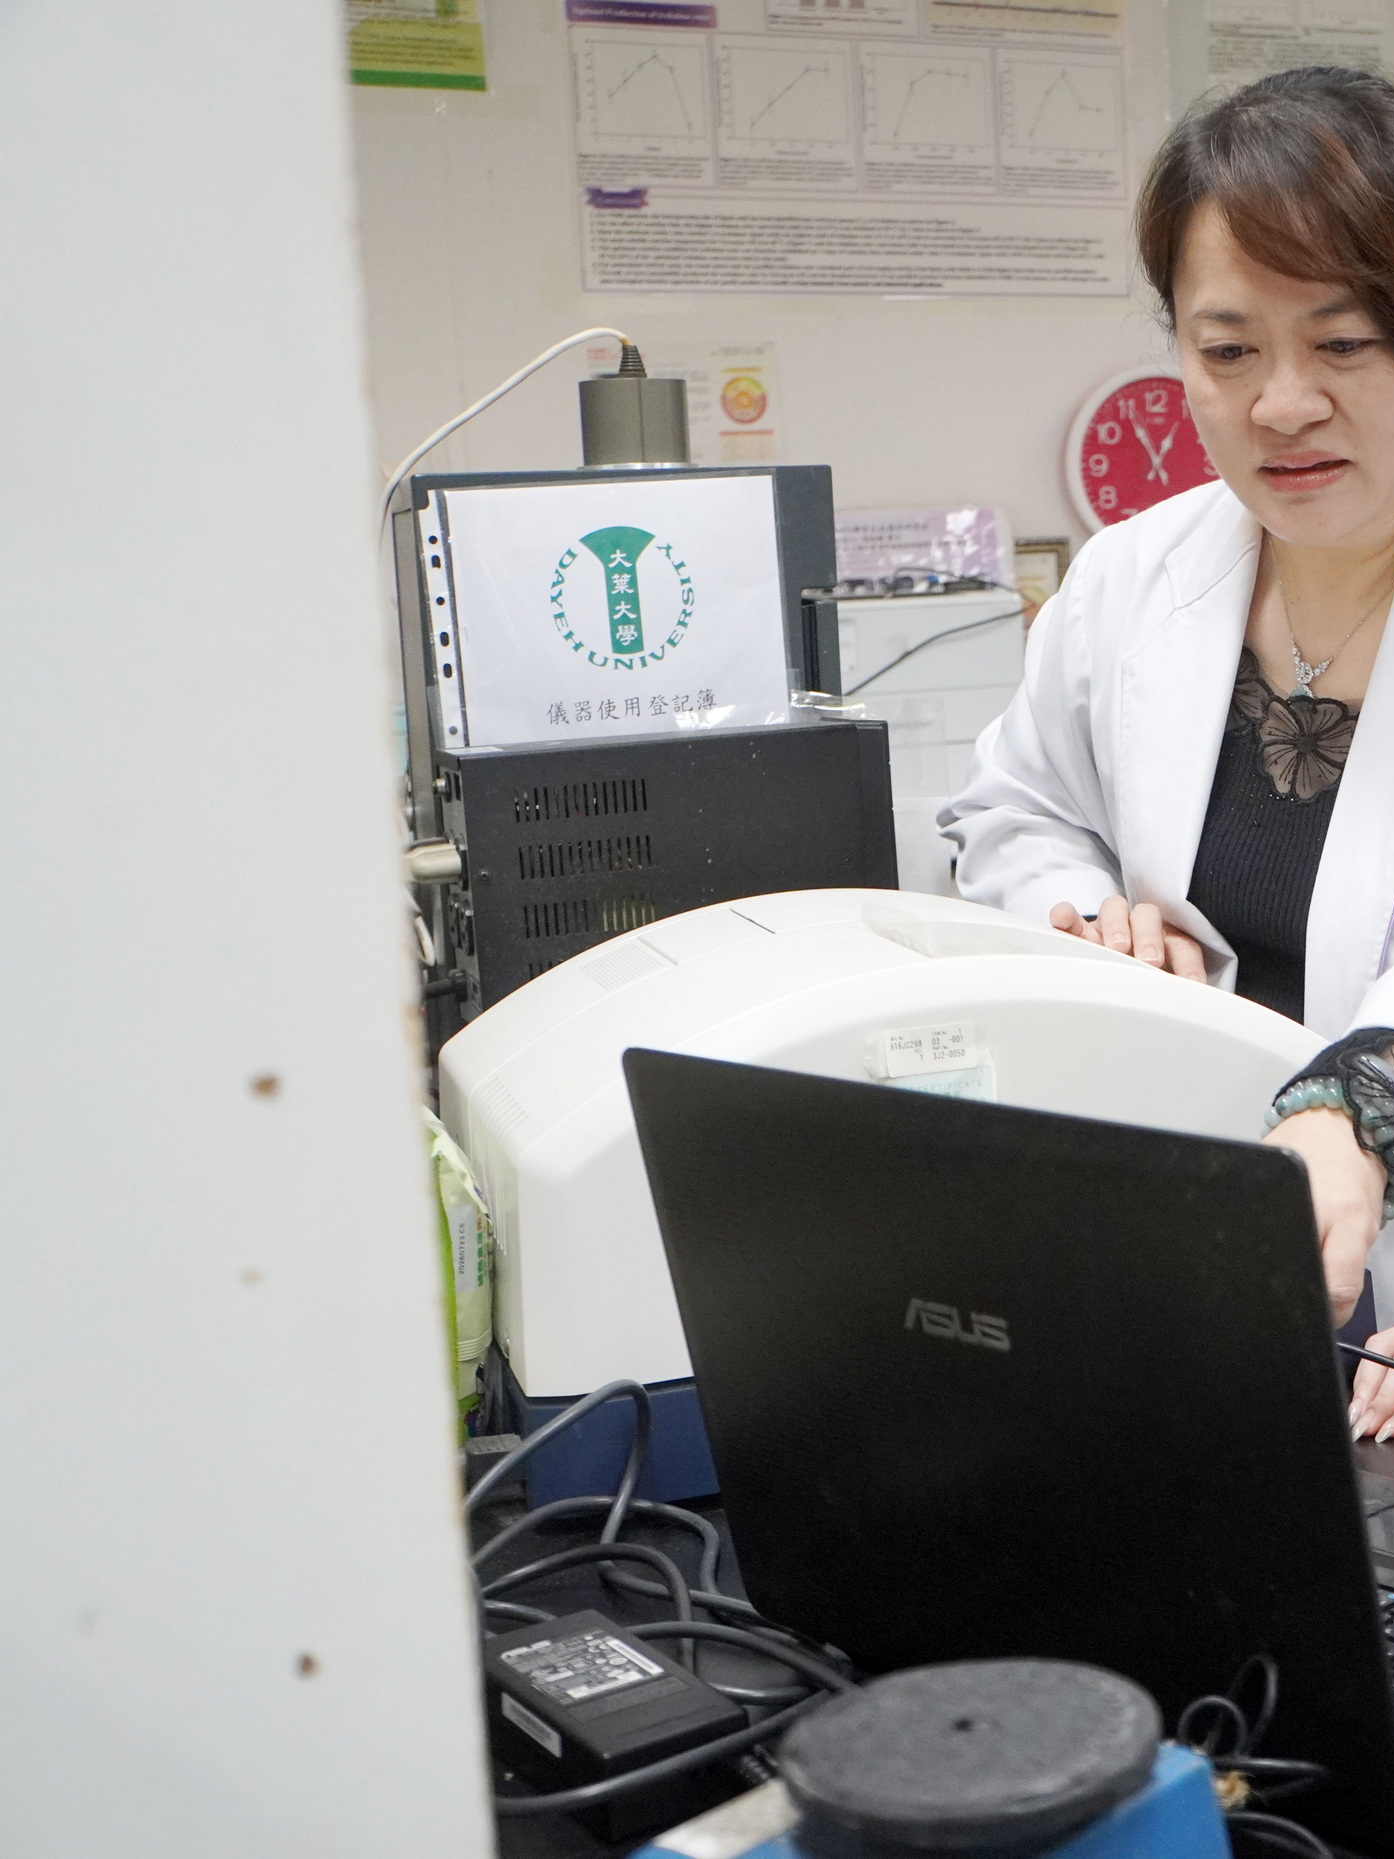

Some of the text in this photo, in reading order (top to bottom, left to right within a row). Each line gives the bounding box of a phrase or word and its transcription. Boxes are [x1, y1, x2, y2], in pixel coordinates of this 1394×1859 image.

[1118, 399, 1136, 420] 11
[1144, 389, 1168, 413] 12
[1097, 421, 1122, 445] 10
[1089, 454, 1110, 477] 9
[1099, 485, 1118, 509] 8
[550, 542, 695, 671] DAYEH UNIVERSITY
[608, 549, 638, 646] 大葉大學
[547, 688, 717, 726] 儀器使用登記簿
[904, 1298, 1011, 1351] ASUS
